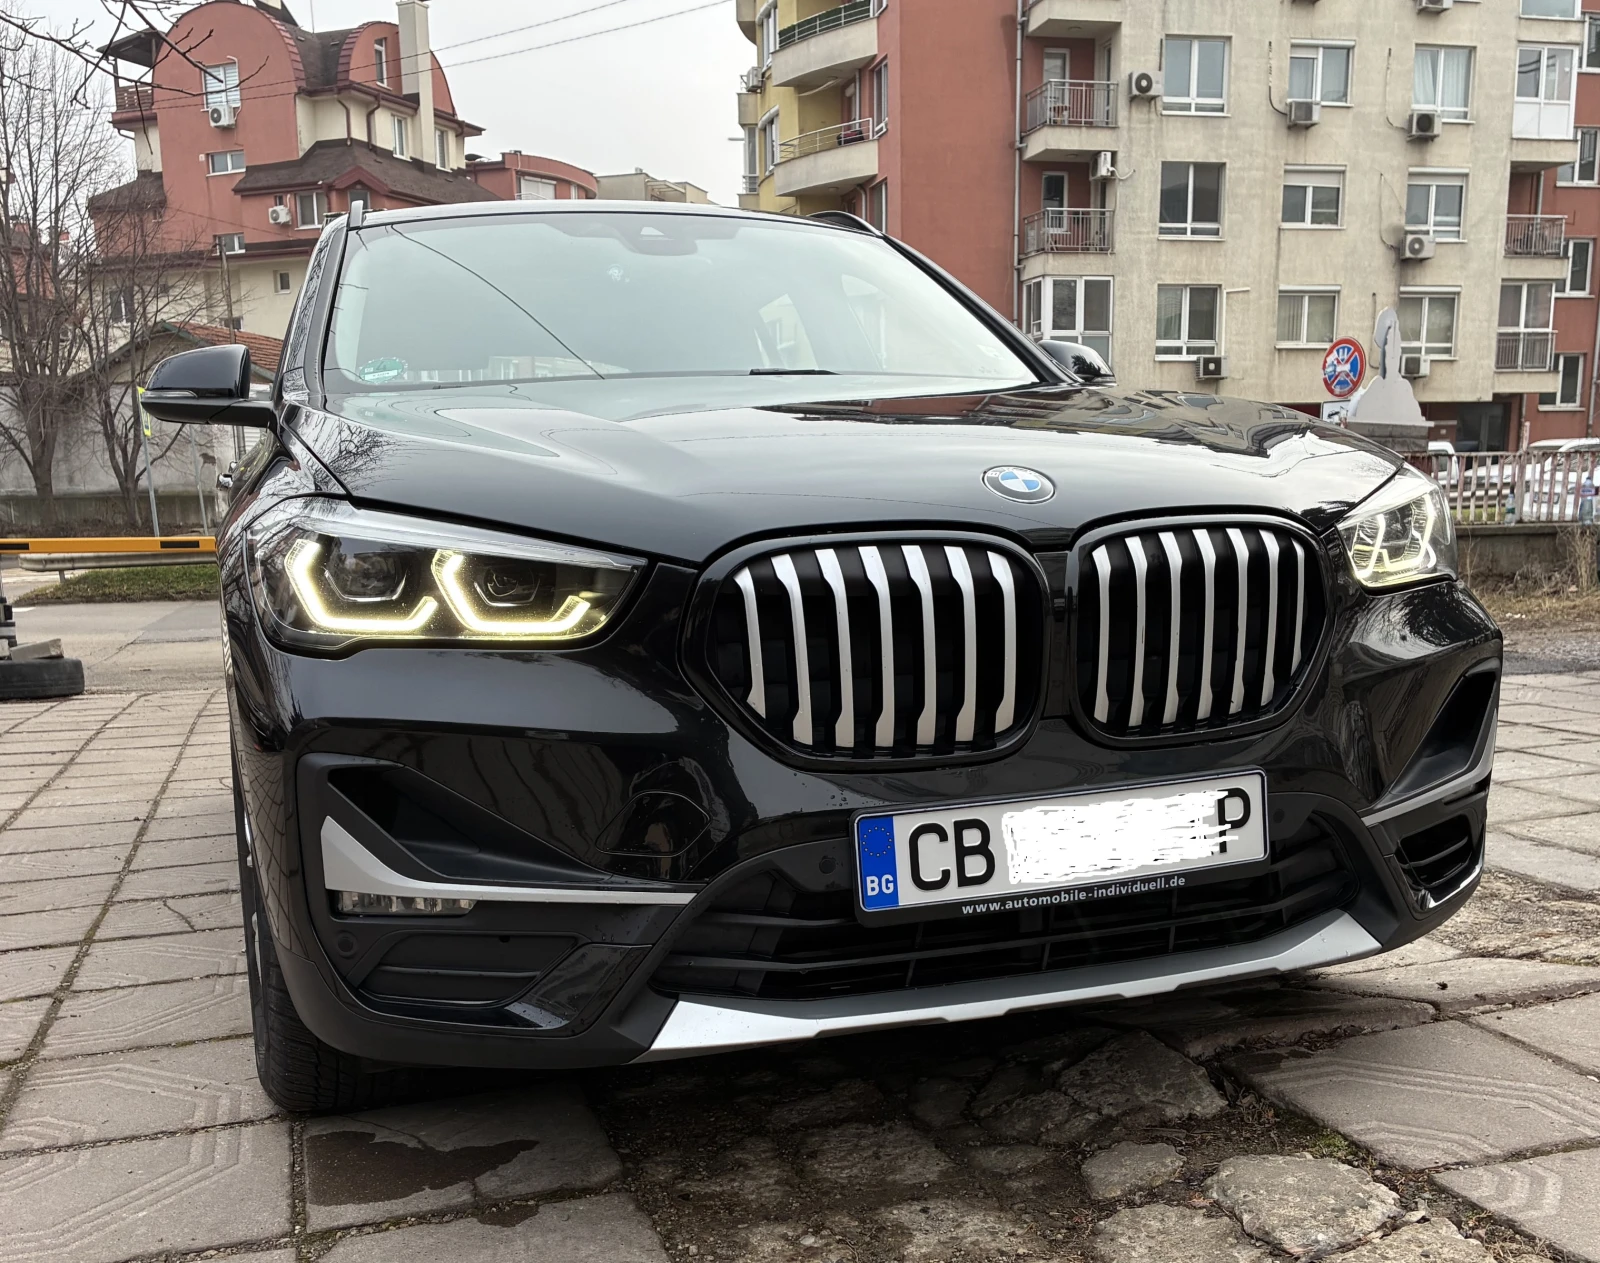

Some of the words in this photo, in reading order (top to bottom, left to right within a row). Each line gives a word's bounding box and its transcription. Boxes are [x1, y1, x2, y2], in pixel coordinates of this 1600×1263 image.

[908, 818, 996, 891] CB
[866, 874, 894, 896] BG
[962, 875, 1186, 915] www.automobile-individuell.de
